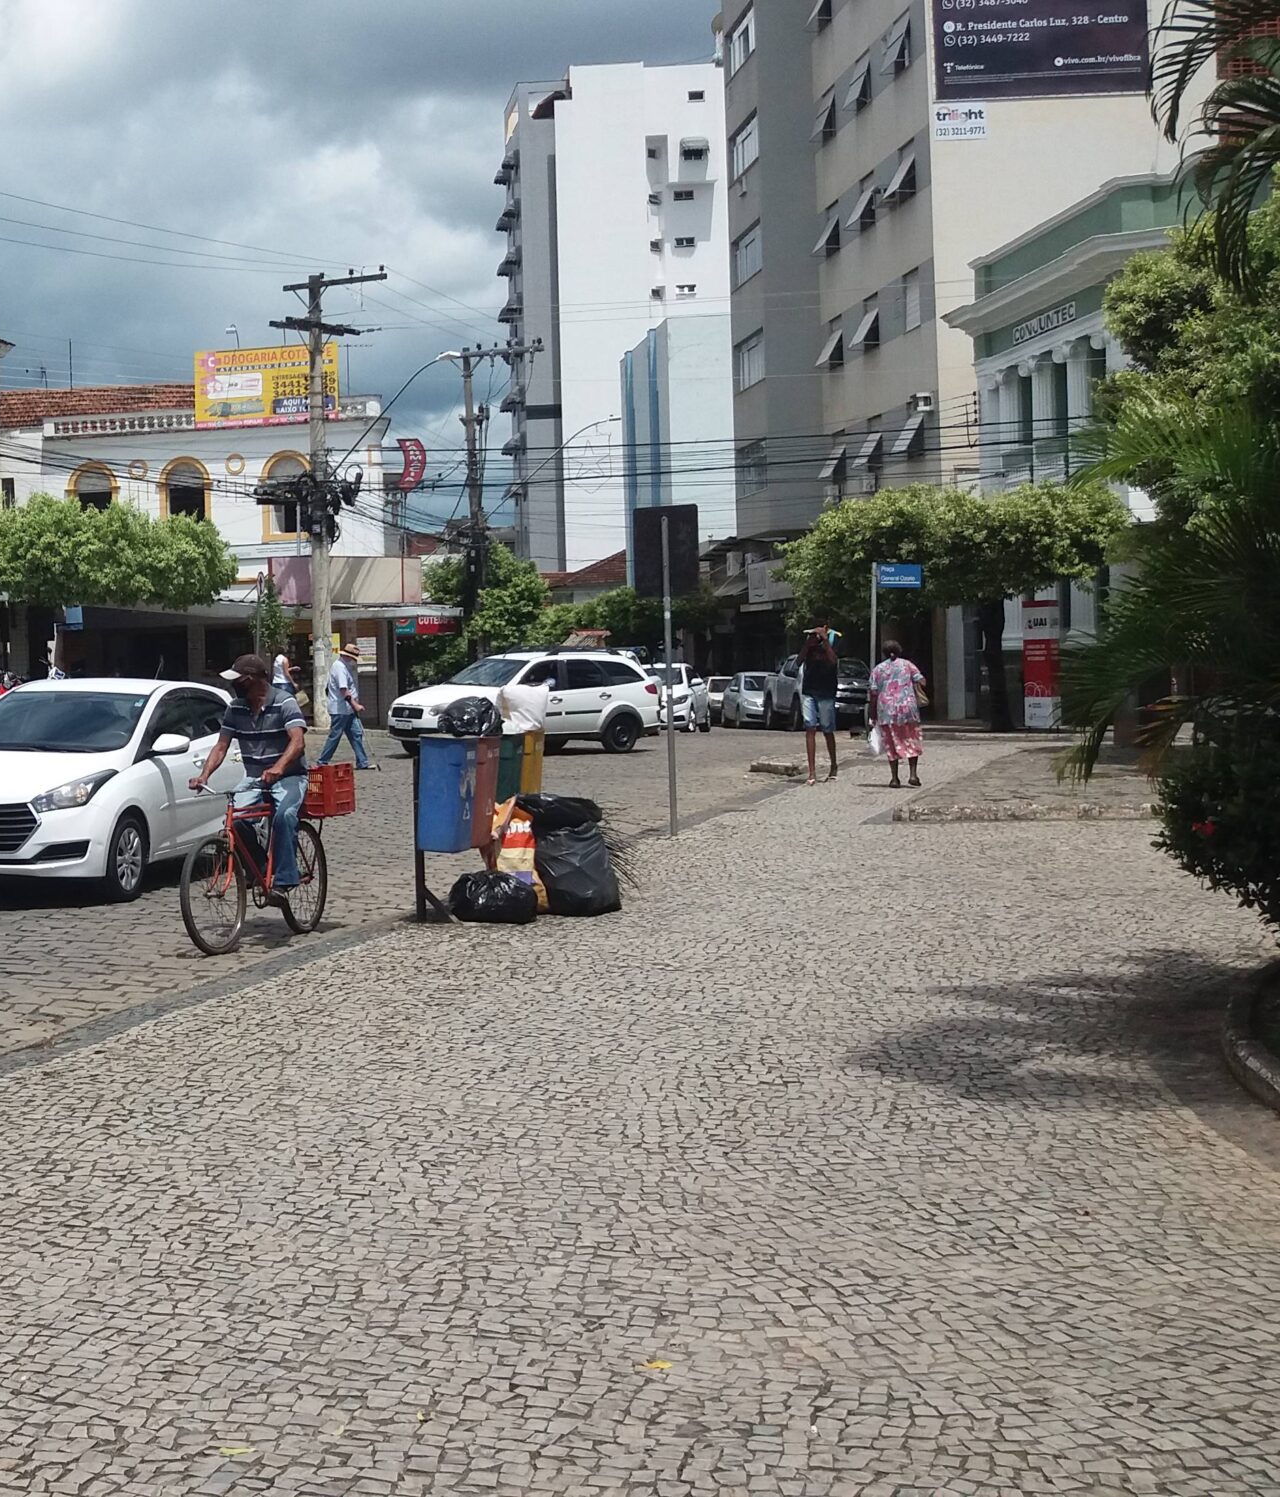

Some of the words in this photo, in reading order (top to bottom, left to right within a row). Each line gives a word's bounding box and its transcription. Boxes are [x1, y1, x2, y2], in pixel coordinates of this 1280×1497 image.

[956, 22, 966, 32] R.
[968, 20, 1017, 31] Presidente
[1019, 17, 1048, 28] Carlos
[1049, 17, 1069, 26] Luz,
[1071, 15, 1089, 25] 328
[1097, 14, 1129, 24] Centro
[957, 35, 977, 47] (32)
[980, 32, 1030, 44] 3449-7222
[936, 107, 984, 123] trilight
[935, 127, 950, 137] (32)
[951, 126, 985, 136] 3211-9771
[1014, 303, 1075, 342] CONJUNTEC
[223, 352, 277, 365] DROGARIA
[280, 346, 332, 360] COTEE
[1033, 617, 1047, 627] UAI
